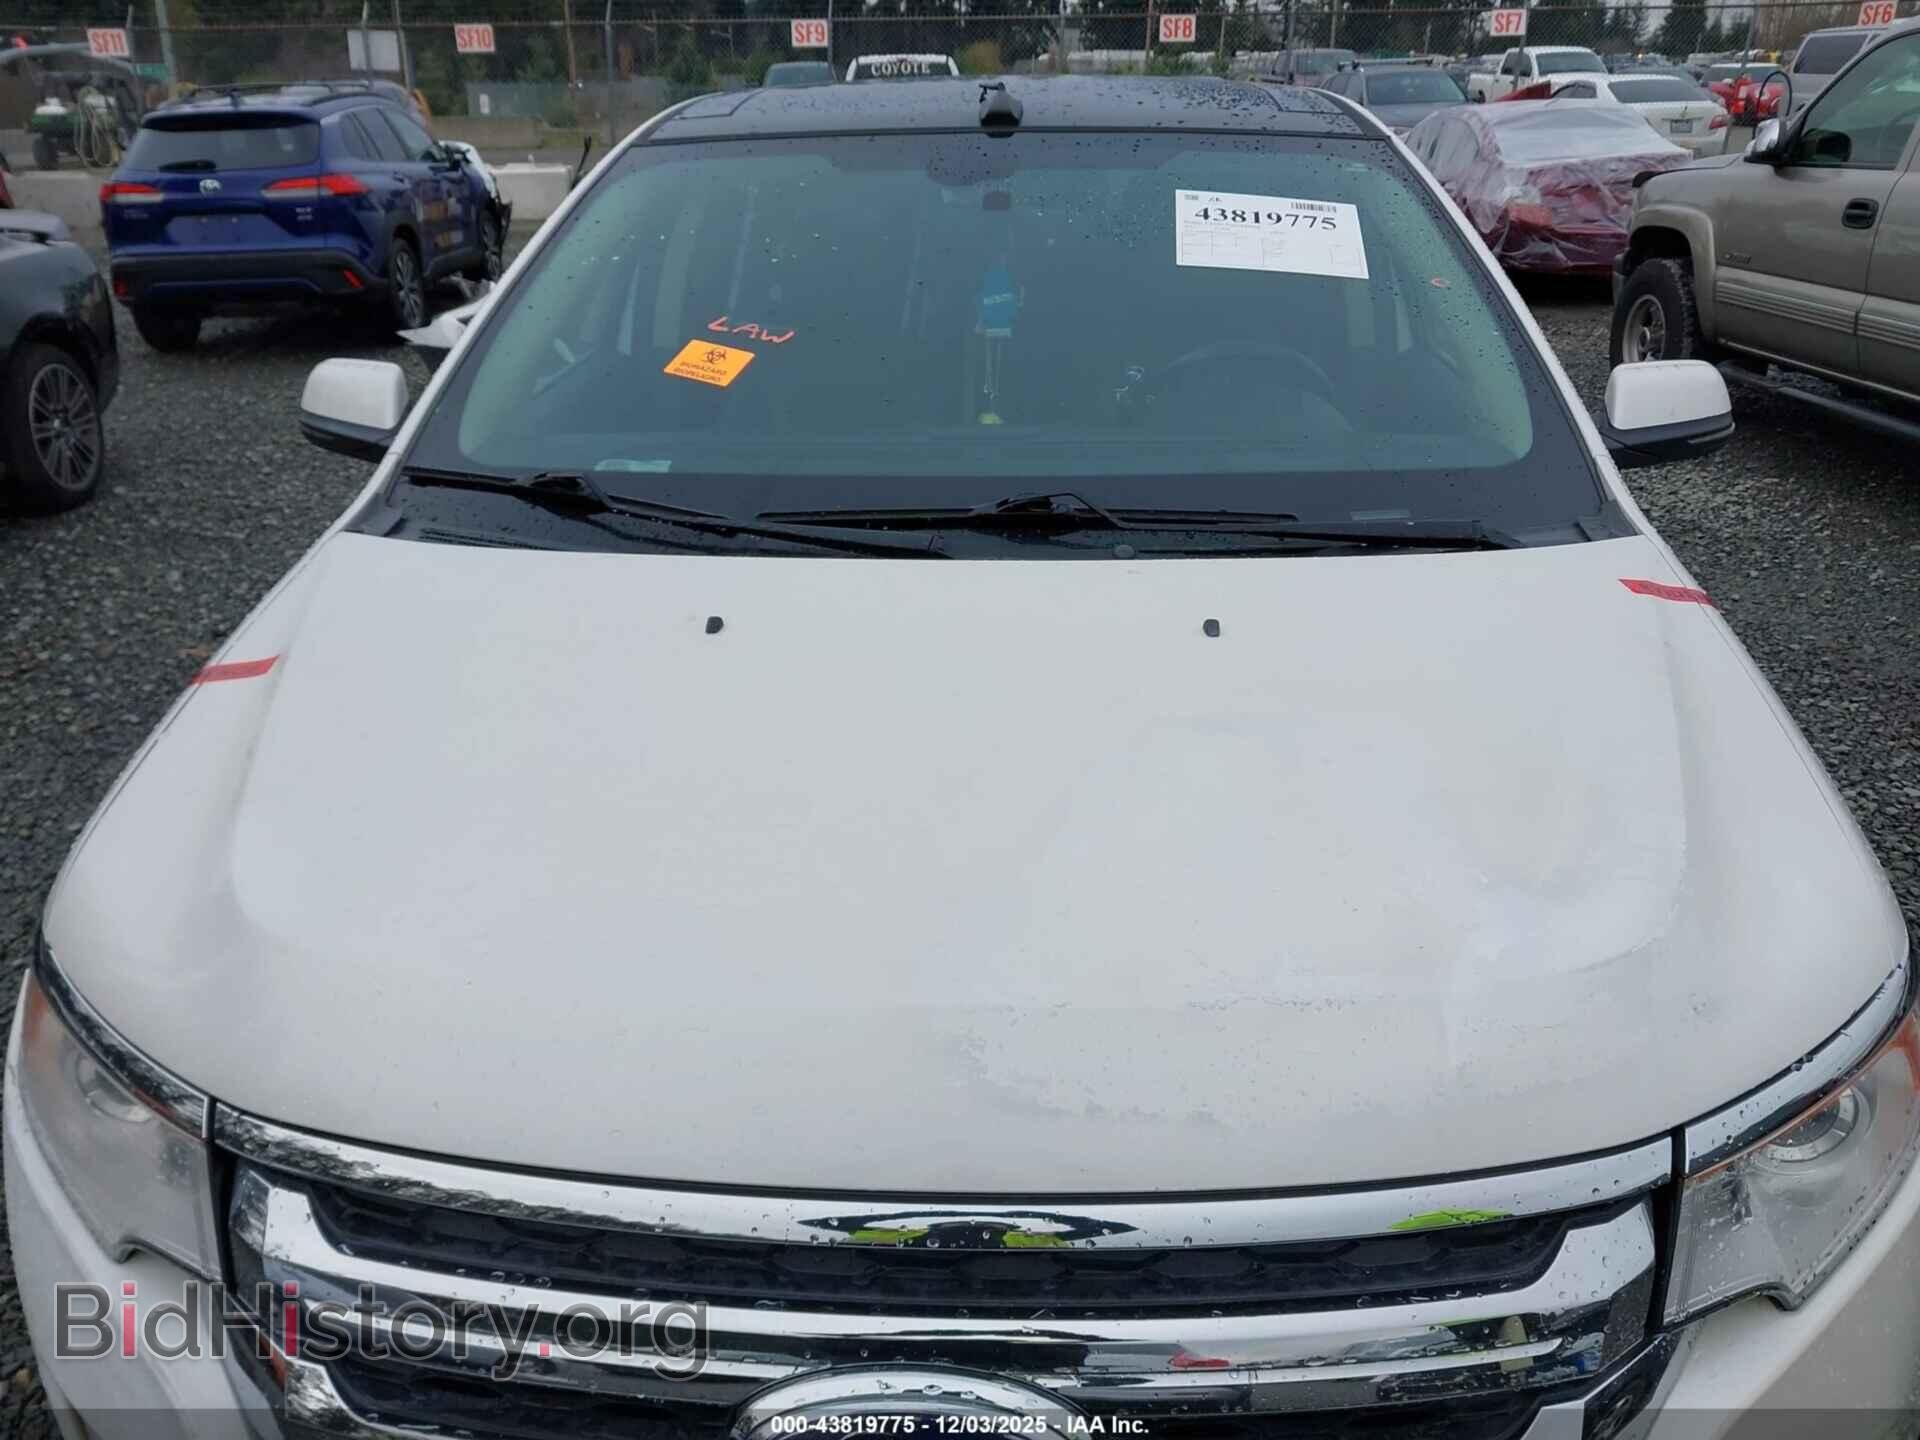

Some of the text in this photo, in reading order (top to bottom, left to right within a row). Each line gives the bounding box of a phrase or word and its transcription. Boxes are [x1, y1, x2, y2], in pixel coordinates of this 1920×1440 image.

[1494, 12, 1522, 33] SF7
[1861, 3, 1894, 26] SF6
[457, 26, 493, 49] SF10
[794, 21, 825, 43] SF9
[1163, 16, 1192, 38] SF8
[91, 31, 125, 53] SF11
[871, 61, 931, 77] COYOTE
[1194, 207, 1337, 231] 43819775
[707, 315, 796, 344] LAW
